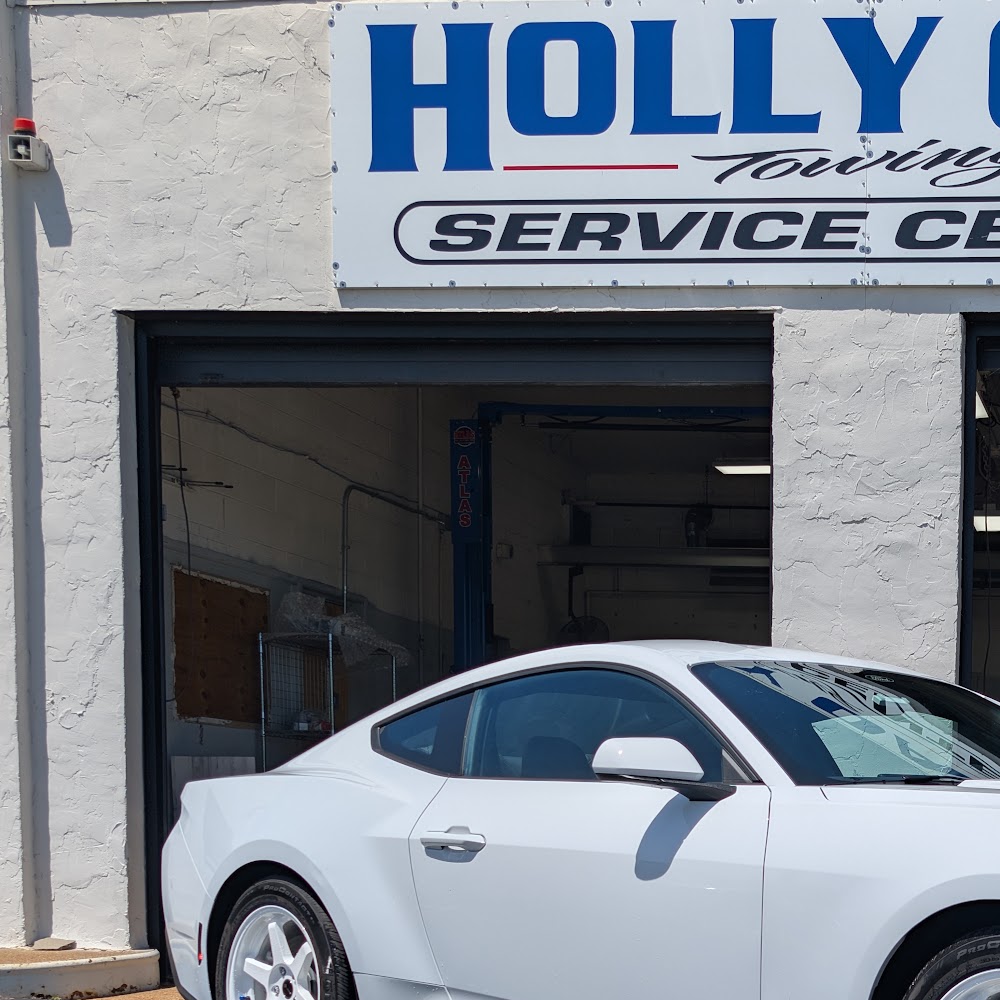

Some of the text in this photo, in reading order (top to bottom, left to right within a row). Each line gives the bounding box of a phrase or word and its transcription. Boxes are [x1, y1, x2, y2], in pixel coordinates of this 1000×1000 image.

[366, 17, 944, 172] HOLLY
[429, 211, 869, 252] SERVICE
[457, 455, 472, 528] ATLAS
